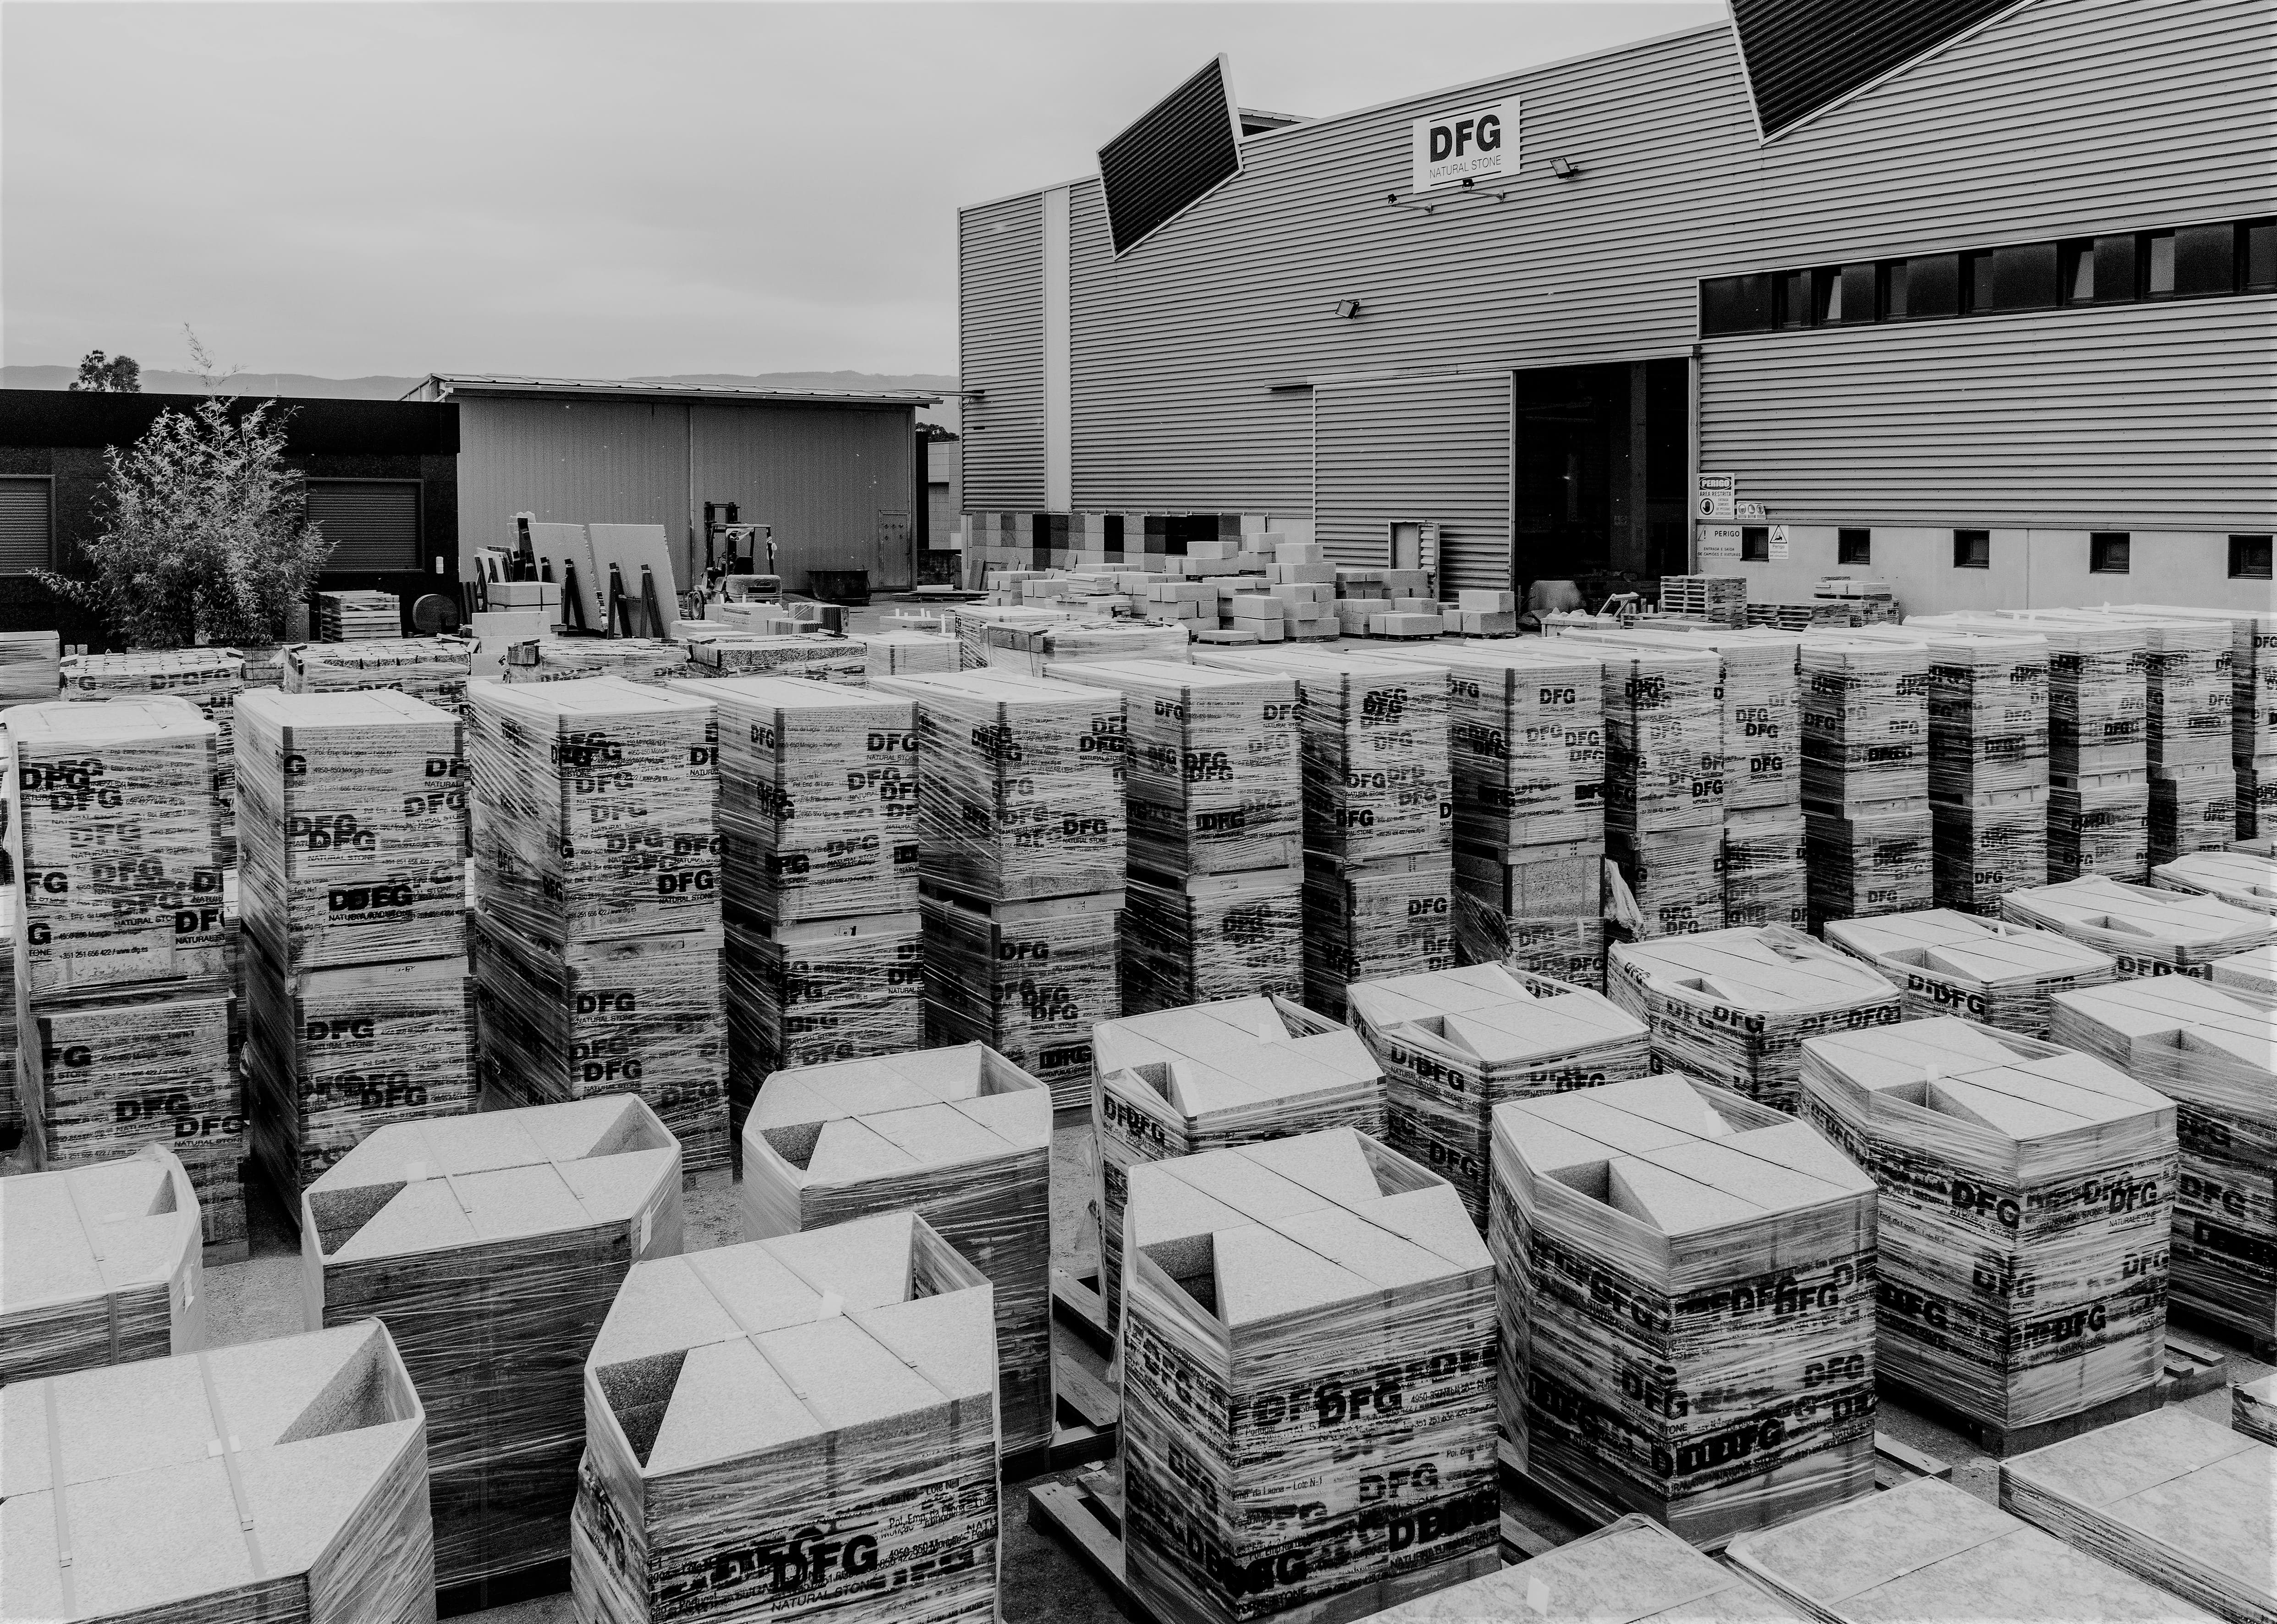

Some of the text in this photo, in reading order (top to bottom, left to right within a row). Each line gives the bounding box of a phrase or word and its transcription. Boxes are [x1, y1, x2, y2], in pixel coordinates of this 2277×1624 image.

[1430, 115, 1500, 162] DFG
[1429, 155, 1501, 178] NATURAL STONE
[1540, 688, 1575, 704] DFG
[1154, 699, 1184, 721] DFG
[751, 725, 774, 749] DFG
[1565, 730, 1599, 746] DFG
[1745, 722, 1778, 738] DFG
[868, 733, 919, 752] DFG
[1080, 736, 1125, 753] DFG
[1751, 756, 1782, 772] DFG
[848, 767, 900, 791] DFG
[1346, 773, 1386, 788] DFG
[1692, 779, 1723, 798] DFG
[1063, 819, 1108, 835] DFG
[1336, 809, 1373, 827] DFG
[309, 830, 375, 851] DFG
[24, 872, 68, 893] FG
[658, 870, 714, 894] DFG
[1974, 871, 2003, 885] DFG
[659, 896, 689, 904] NATURAL
[1408, 897, 1447, 915] DFG
[1867, 889, 1897, 903] DFG
[176, 909, 225, 934] DF
[1000, 941, 1048, 960] DFG
[577, 993, 635, 1014] DFG
[1934, 985, 1985, 1016] DFG
[1031, 1003, 1078, 1022] DFG
[1713, 1005, 1765, 1033] DFG
[42, 1045, 91, 1067] FG
[584, 1059, 642, 1082] DFG
[1417, 1057, 1464, 1093] DFG
[1429, 1140, 1479, 1182] DFG
[1952, 1179, 2021, 1229] DFG
[2109, 1181, 2157, 1214] DFG
[2180, 1172, 2245, 1217] DFG
[2109, 1215, 2136, 1227] NATURAL
[1774, 1283, 1839, 1316] DFG
[2056, 1305, 2106, 1343] DFG
[1805, 1354, 1864, 1388] DFG
[1318, 1381, 1402, 1427] DFG
[1660, 1423, 1688, 1434] STONE
[1446, 1449, 1458, 1458] Pol.
[1294, 1479, 1308, 1491] Lote
[1310, 1476, 1322, 1486] N-1
[1360, 1462, 1438, 1503] DFG
[772, 1534, 878, 1595] DFG
[772, 1590, 833, 1613] NATURAL
